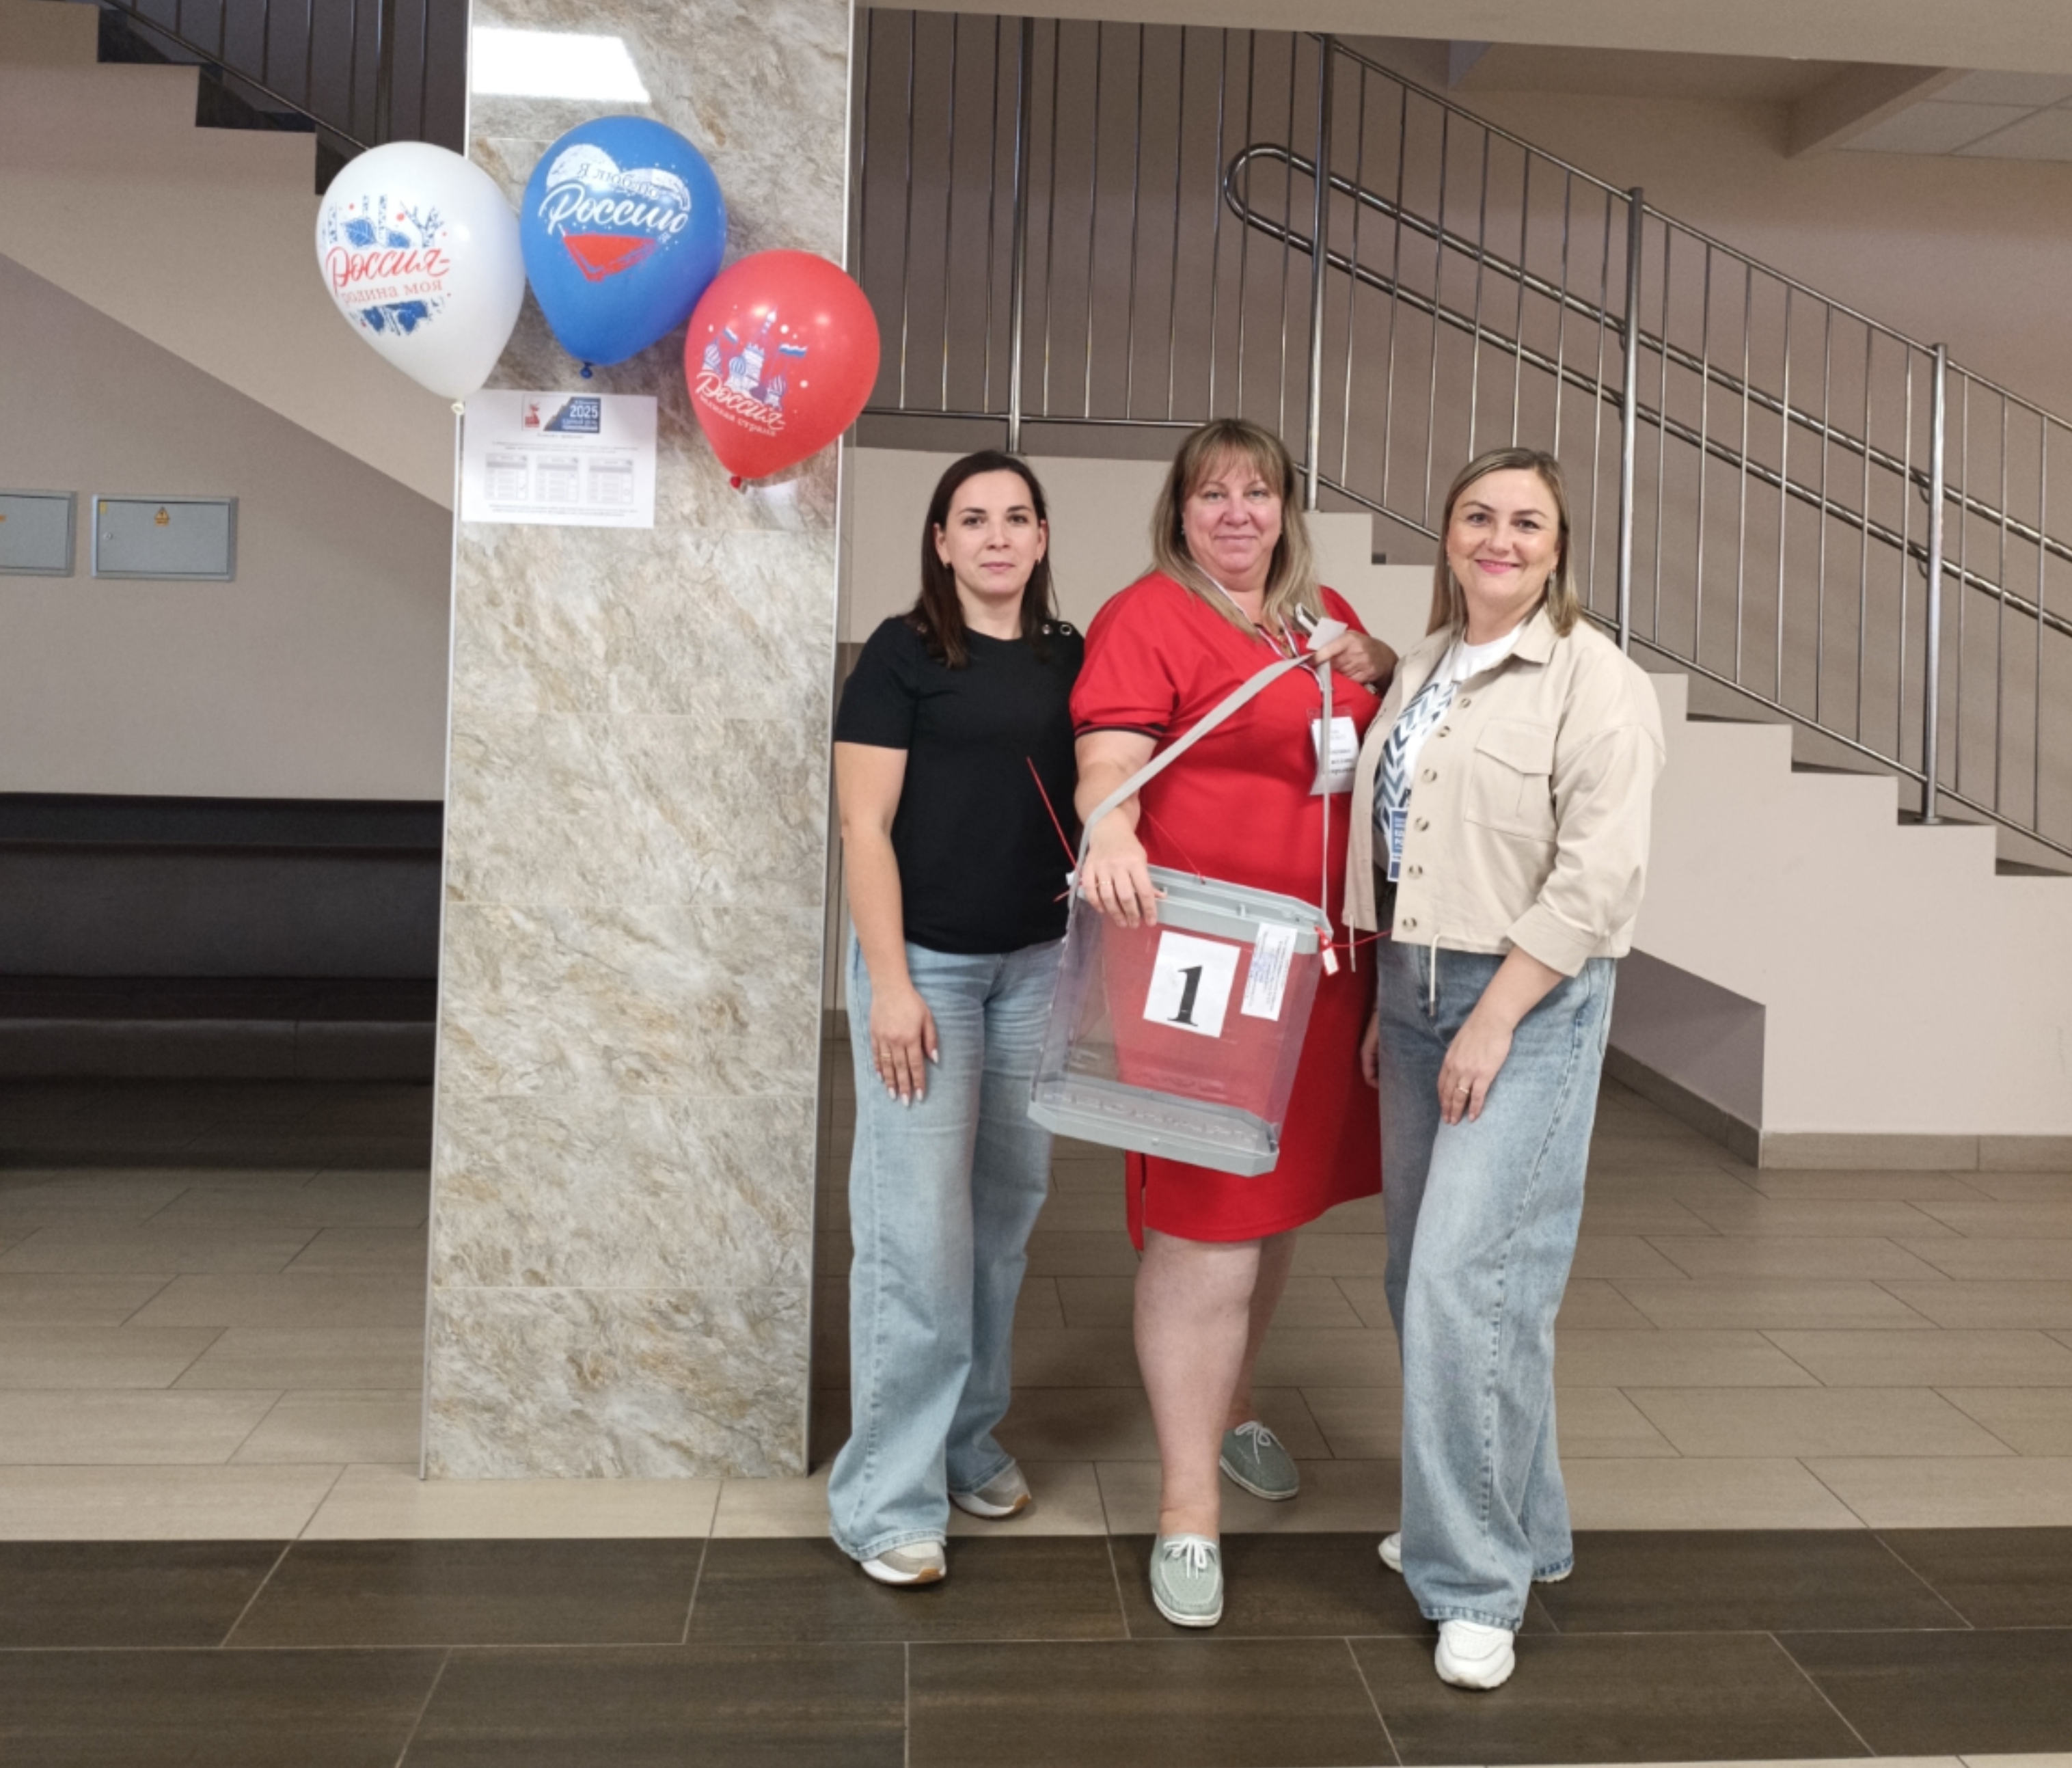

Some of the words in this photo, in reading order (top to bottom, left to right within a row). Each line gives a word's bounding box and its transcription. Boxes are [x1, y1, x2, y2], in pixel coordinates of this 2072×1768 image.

[577, 163, 590, 178] Я
[538, 182, 689, 235] Россию
[342, 286, 399, 304] родина
[404, 280, 443, 296] моя
[569, 405, 599, 419] 2025
[1167, 964, 1203, 1026] 1
